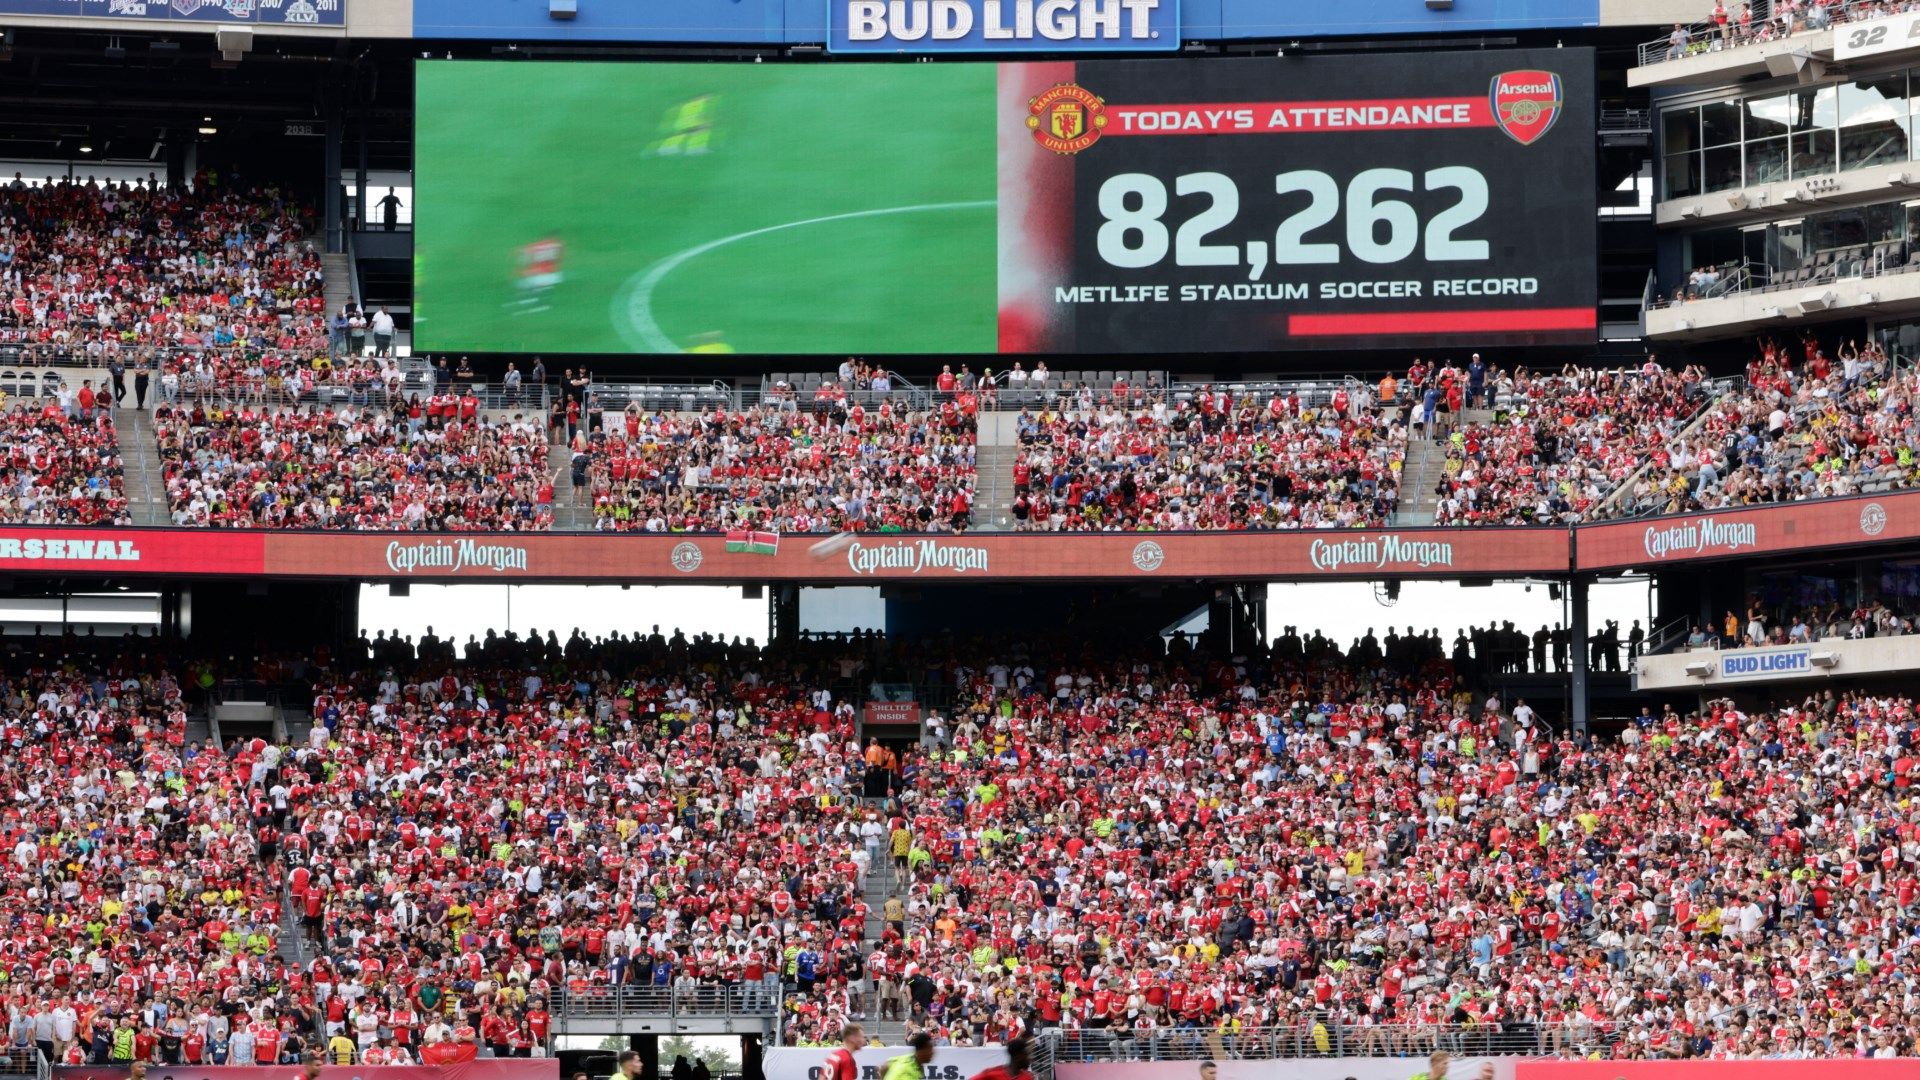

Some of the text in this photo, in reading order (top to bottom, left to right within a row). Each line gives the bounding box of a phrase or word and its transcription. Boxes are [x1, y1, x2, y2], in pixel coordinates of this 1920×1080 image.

[260, 0, 282, 8] 2007
[316, 0, 338, 11] 2011
[848, 0, 1159, 41] BUD LIGHT
[1848, 25, 1888, 49] 32
[1034, 88, 1099, 111] MANCHESTER
[1499, 82, 1552, 95] Arsenal
[1118, 104, 1471, 132] TODAY'S ATTENDANCE
[1044, 137, 1090, 150] UNITED
[1096, 165, 1490, 281] 82,262
[1055, 277, 1538, 304] METLIFE STADIUM SOCCER RECORD
[0, 538, 140, 560] RSENAL
[1644, 518, 1755, 558] Captain Morgan
[385, 538, 527, 572] Captain Morgan
[847, 539, 988, 574] Captain Morgan
[1310, 535, 1452, 570] Captain Morgan
[1725, 652, 1808, 674] BUD LIGHT
[871, 704, 913, 712] SHELTER
[1528, 915, 1540, 926] 10
